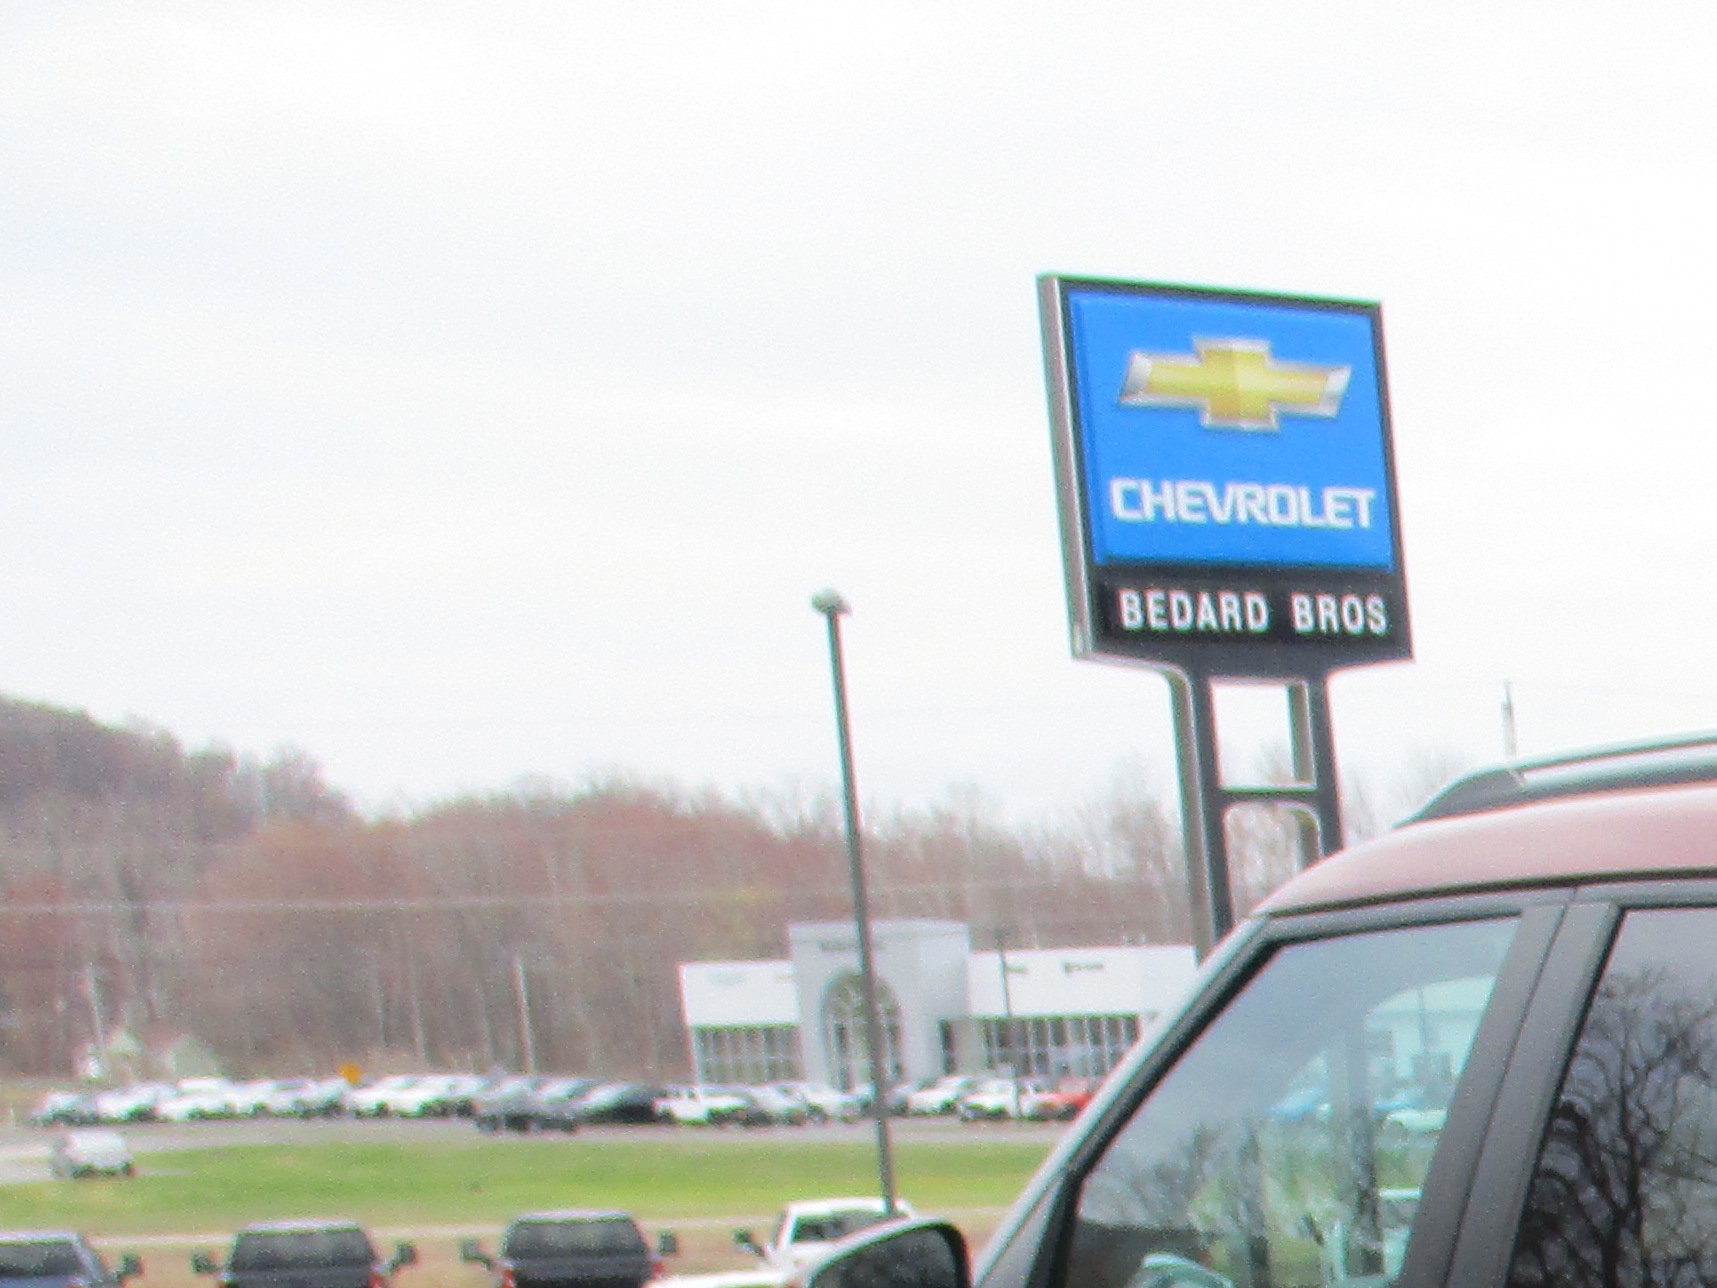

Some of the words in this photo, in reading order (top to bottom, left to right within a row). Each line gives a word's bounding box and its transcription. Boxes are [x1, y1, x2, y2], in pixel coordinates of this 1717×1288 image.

[1109, 477, 1376, 529] CHEVROLET
[1117, 587, 1270, 632] BEDARD
[1291, 592, 1388, 635] BROS
